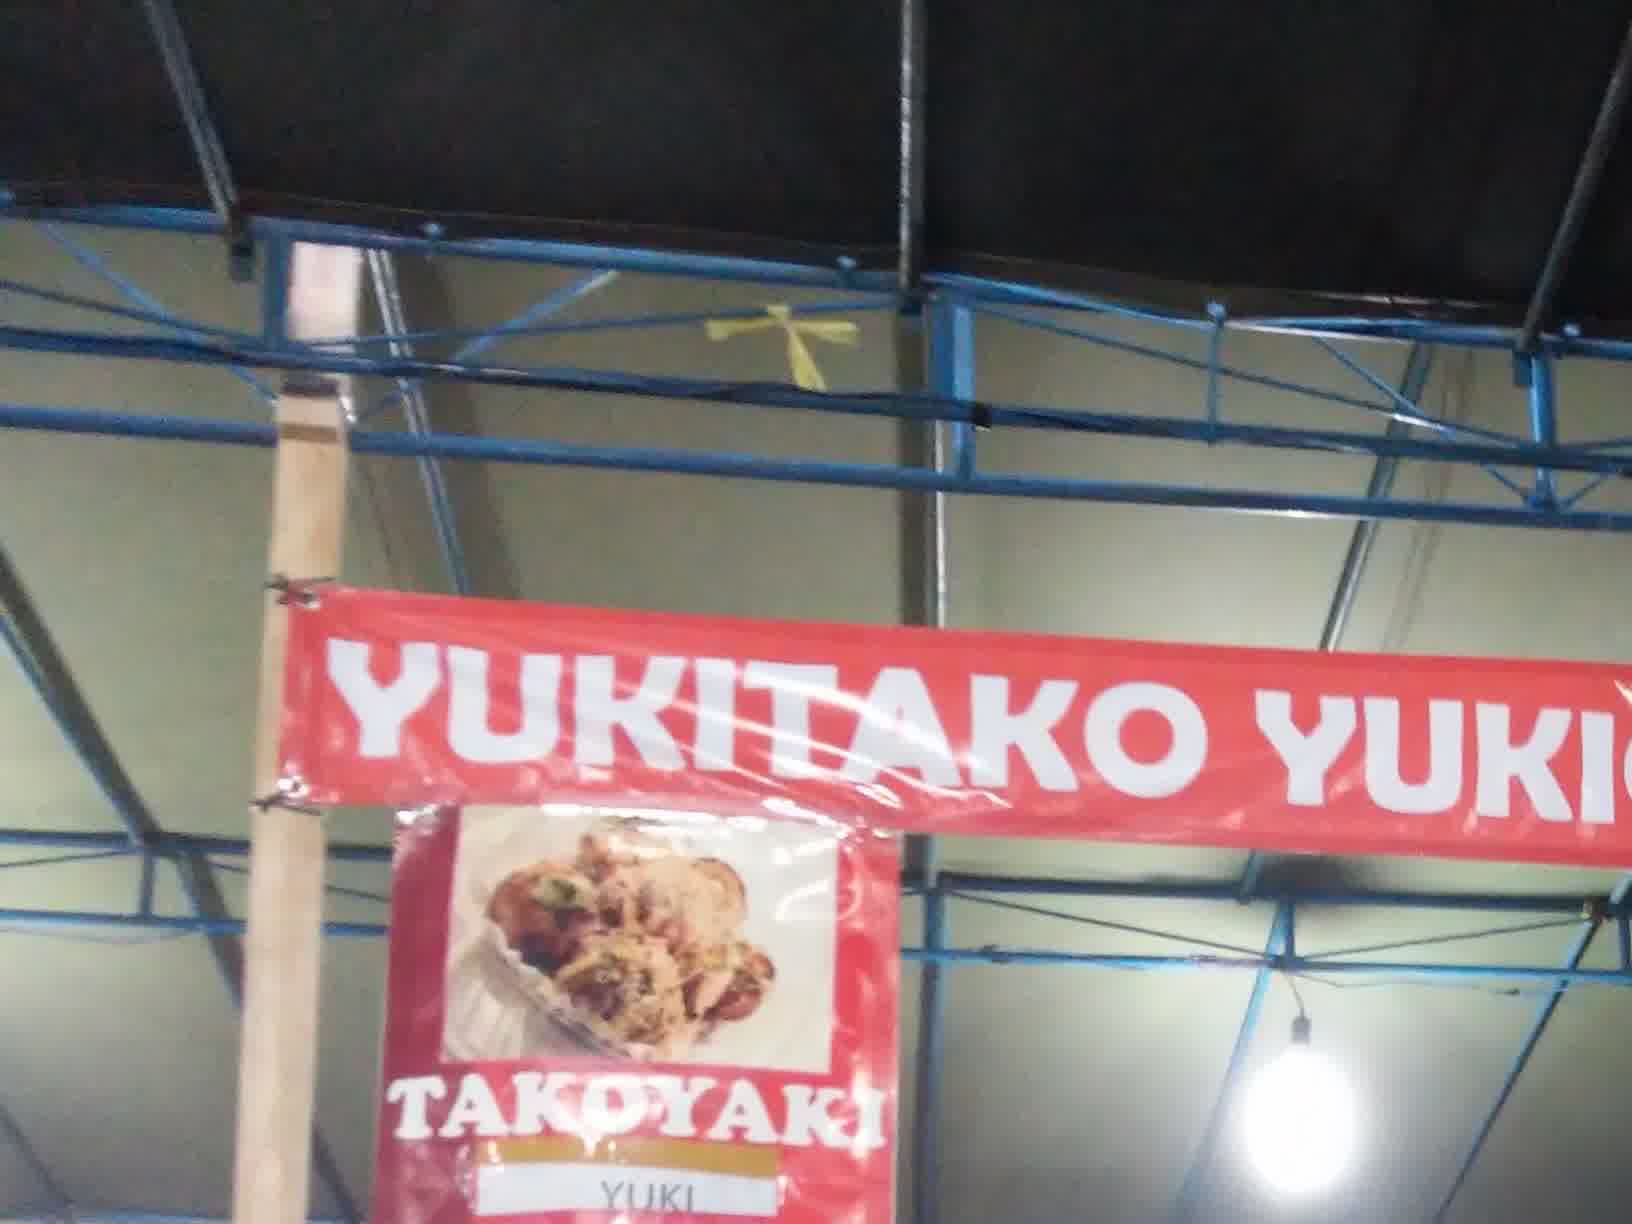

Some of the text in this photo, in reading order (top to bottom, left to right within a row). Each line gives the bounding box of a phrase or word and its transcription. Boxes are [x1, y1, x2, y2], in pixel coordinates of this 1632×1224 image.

[327, 638, 1208, 798] YUKITAKO
[387, 1072, 887, 1149] TAKOYAKI
[601, 1180, 694, 1212] YUKI
